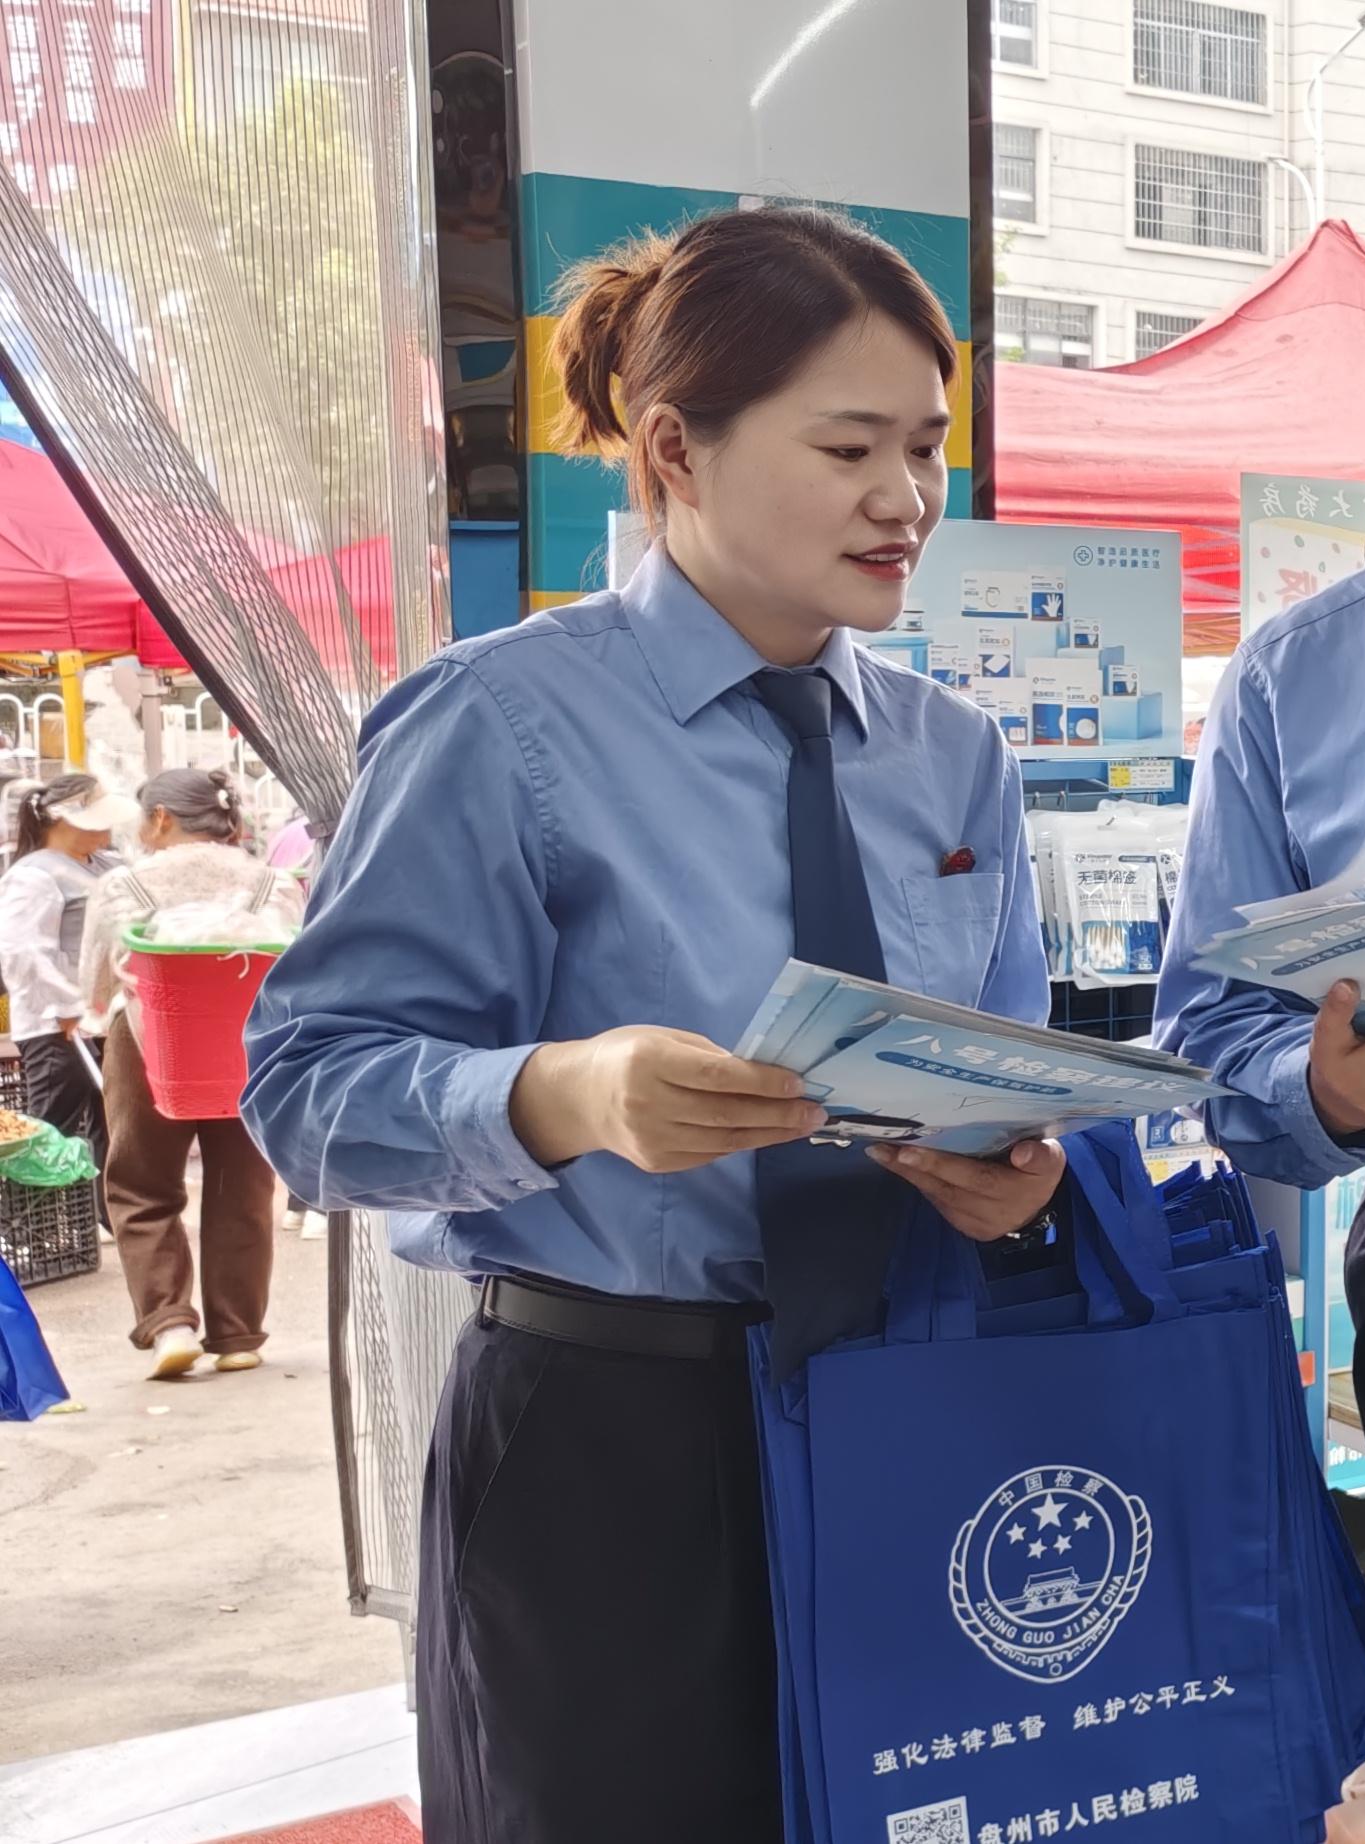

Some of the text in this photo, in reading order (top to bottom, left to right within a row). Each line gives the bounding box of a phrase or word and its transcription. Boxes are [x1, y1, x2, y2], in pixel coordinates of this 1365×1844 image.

[998, 1470, 1105, 1508] 中国检察
[975, 1573, 1125, 1644] ZHONG GUO JIAN CHA
[872, 1675, 1236, 1775] 强化法律监督 维护公平正义
[977, 1773, 1200, 1844] 盘州市人民检察院
